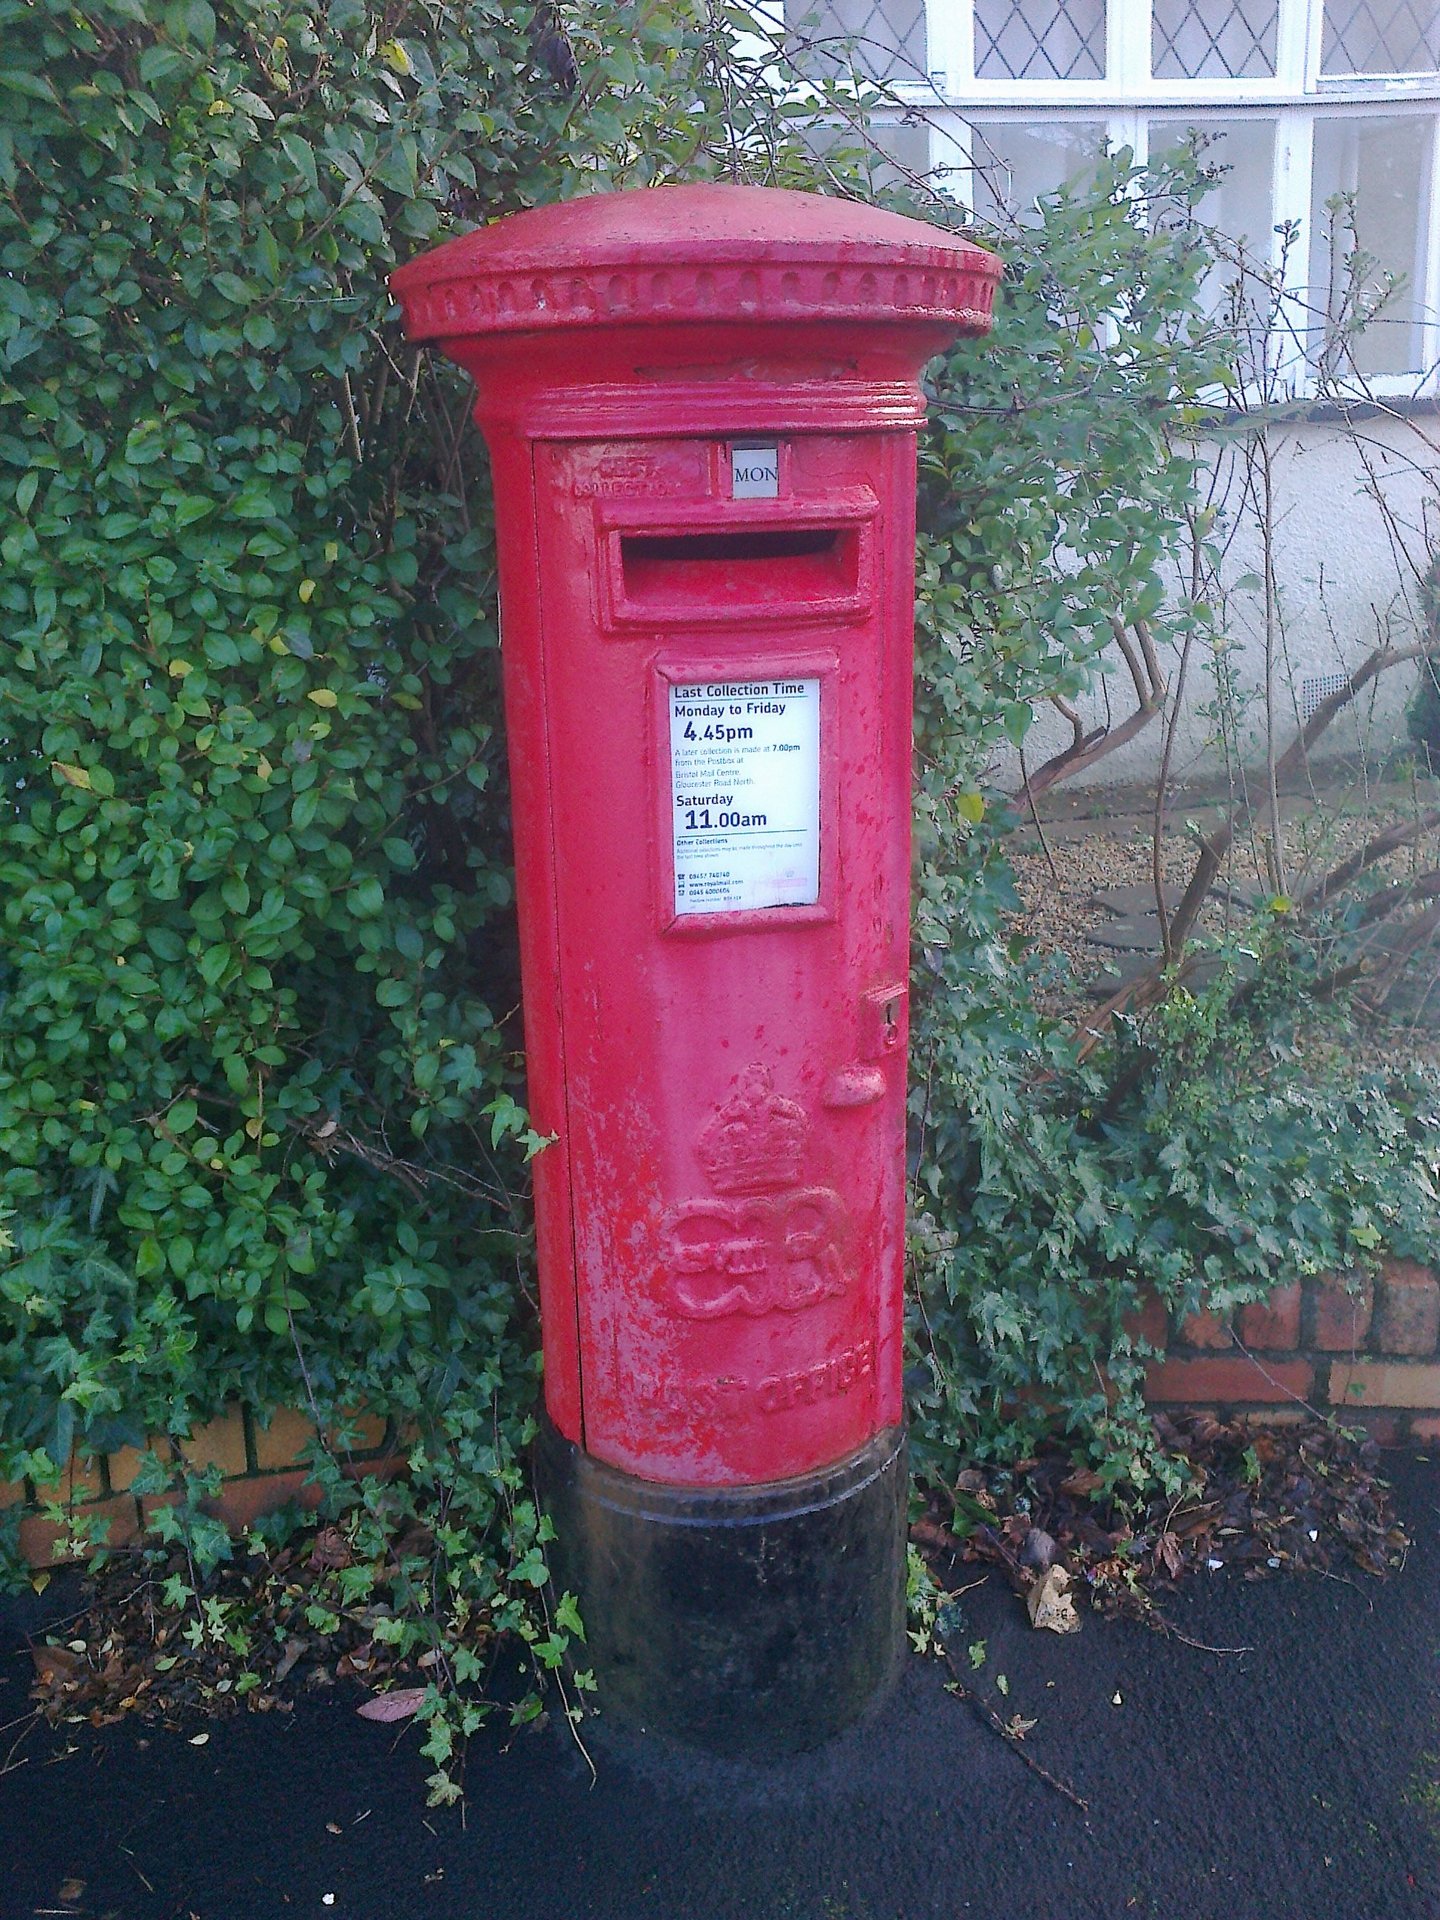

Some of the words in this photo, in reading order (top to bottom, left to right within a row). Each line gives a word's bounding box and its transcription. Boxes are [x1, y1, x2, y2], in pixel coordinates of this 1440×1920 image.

[735, 467, 778, 482] MON
[574, 482, 681, 497] COLLECTIO
[675, 687, 702, 698] Last
[707, 684, 768, 697] Collection
[772, 683, 804, 694] Time
[675, 704, 725, 718] Monday
[730, 704, 742, 714] to
[746, 702, 786, 715] Friday
[684, 721, 753, 742] 4.45pm
[682, 748, 698, 756] later
[700, 746, 732, 755] collection
[772, 744, 800, 752] 7.00pm
[694, 758, 706, 766] the
[700, 770, 714, 778] Mail
[676, 780, 712, 788] Gloucester
[676, 794, 734, 806] Saturday
[685, 808, 767, 830] 11.00am
